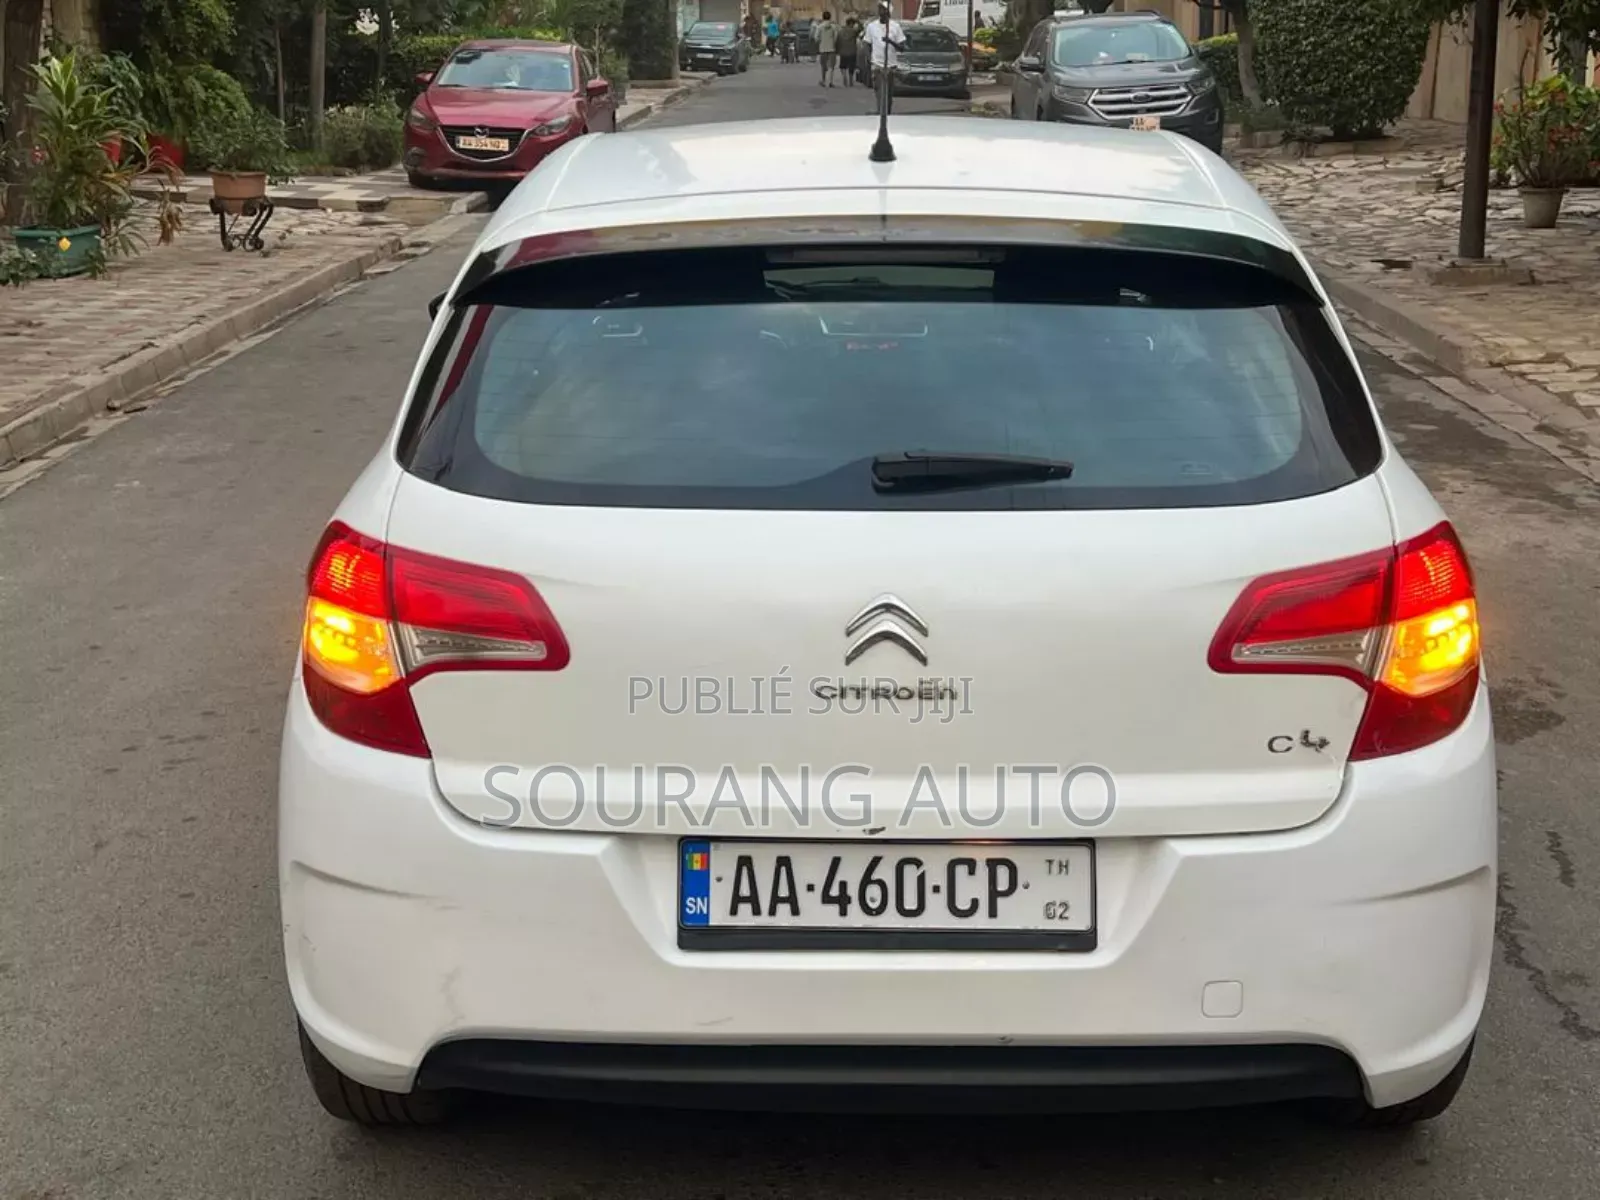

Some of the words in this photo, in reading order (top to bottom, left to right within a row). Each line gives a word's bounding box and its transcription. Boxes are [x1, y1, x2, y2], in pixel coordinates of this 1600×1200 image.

[1267, 729, 1330, 754] C4
[1044, 858, 1070, 876] TH
[685, 896, 708, 915] SN
